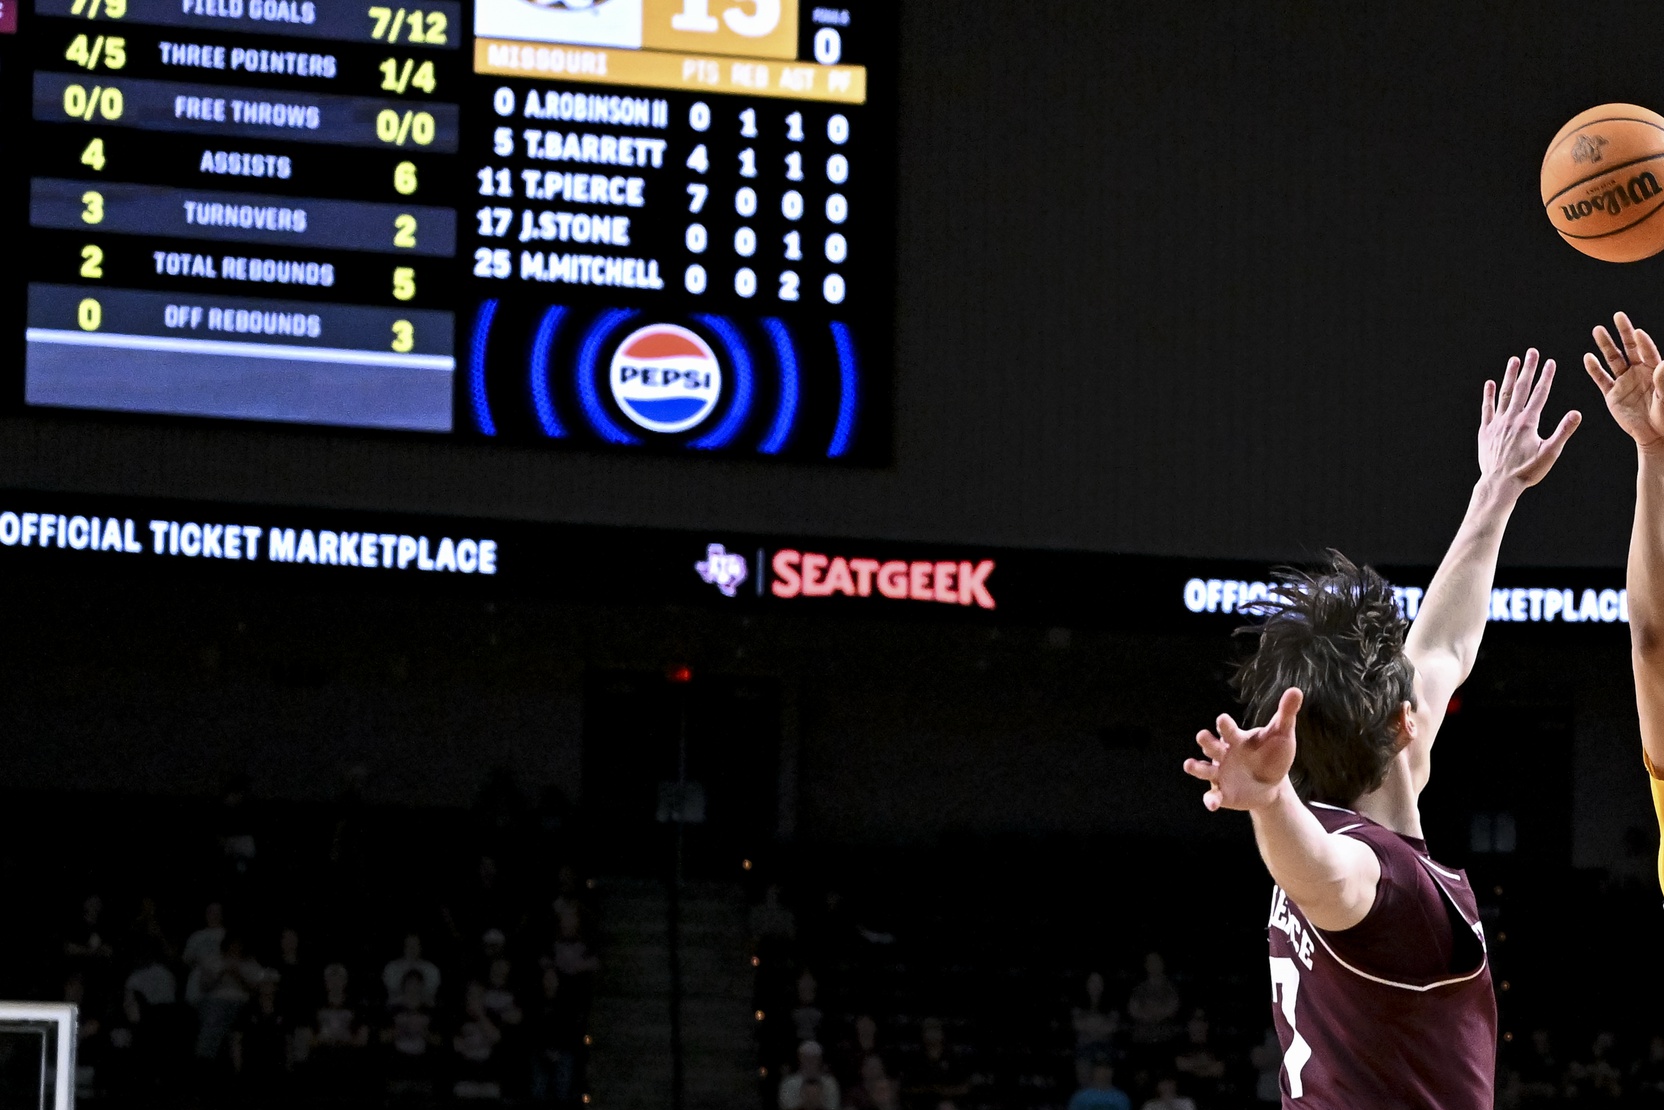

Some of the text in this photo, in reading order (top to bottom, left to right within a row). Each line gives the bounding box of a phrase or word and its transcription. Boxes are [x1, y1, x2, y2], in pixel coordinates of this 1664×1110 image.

[248, 0, 316, 25] GOALS
[369, 7, 447, 44] 7/12
[813, 28, 841, 65] 0
[66, 34, 436, 94] 4/5 THREE POINTERS 1/4
[487, 44, 609, 76] MISSOURI
[682, 60, 719, 85] PTS
[64, 84, 435, 146] 0/0 FREE THROWS 0/0
[493, 86, 516, 117] 0
[524, 89, 650, 126] A.ROBINSON
[688, 101, 712, 133] 0
[738, 108, 758, 138] 1
[784, 111, 804, 142] 1
[826, 114, 850, 145] 0
[82, 138, 417, 195] 4 ASSISTS 6
[493, 126, 849, 185] 5 T.BARRETT 4 1 1 0
[82, 191, 417, 248] 3 TURNOVERS 2
[477, 166, 849, 225] 11 T.PIERCE 7 0 0 0
[1559, 170, 1663, 222] Wilson
[475, 206, 848, 264] 17 J.STONE 0 0 1 0
[81, 245, 416, 301] 2 TOTAL REBOUNDS 5
[473, 247, 846, 305] 25 M.MITCHELL 0 0 2 0
[78, 298, 415, 354] 0 OFF REBOUNDS 3
[620, 365, 711, 389] PEPSI
[0, 511, 497, 574] OFFICIAL TICKET MARKETPLACE
[772, 549, 996, 609] SEATGEEK
[1269, 956, 1312, 1099] 7
